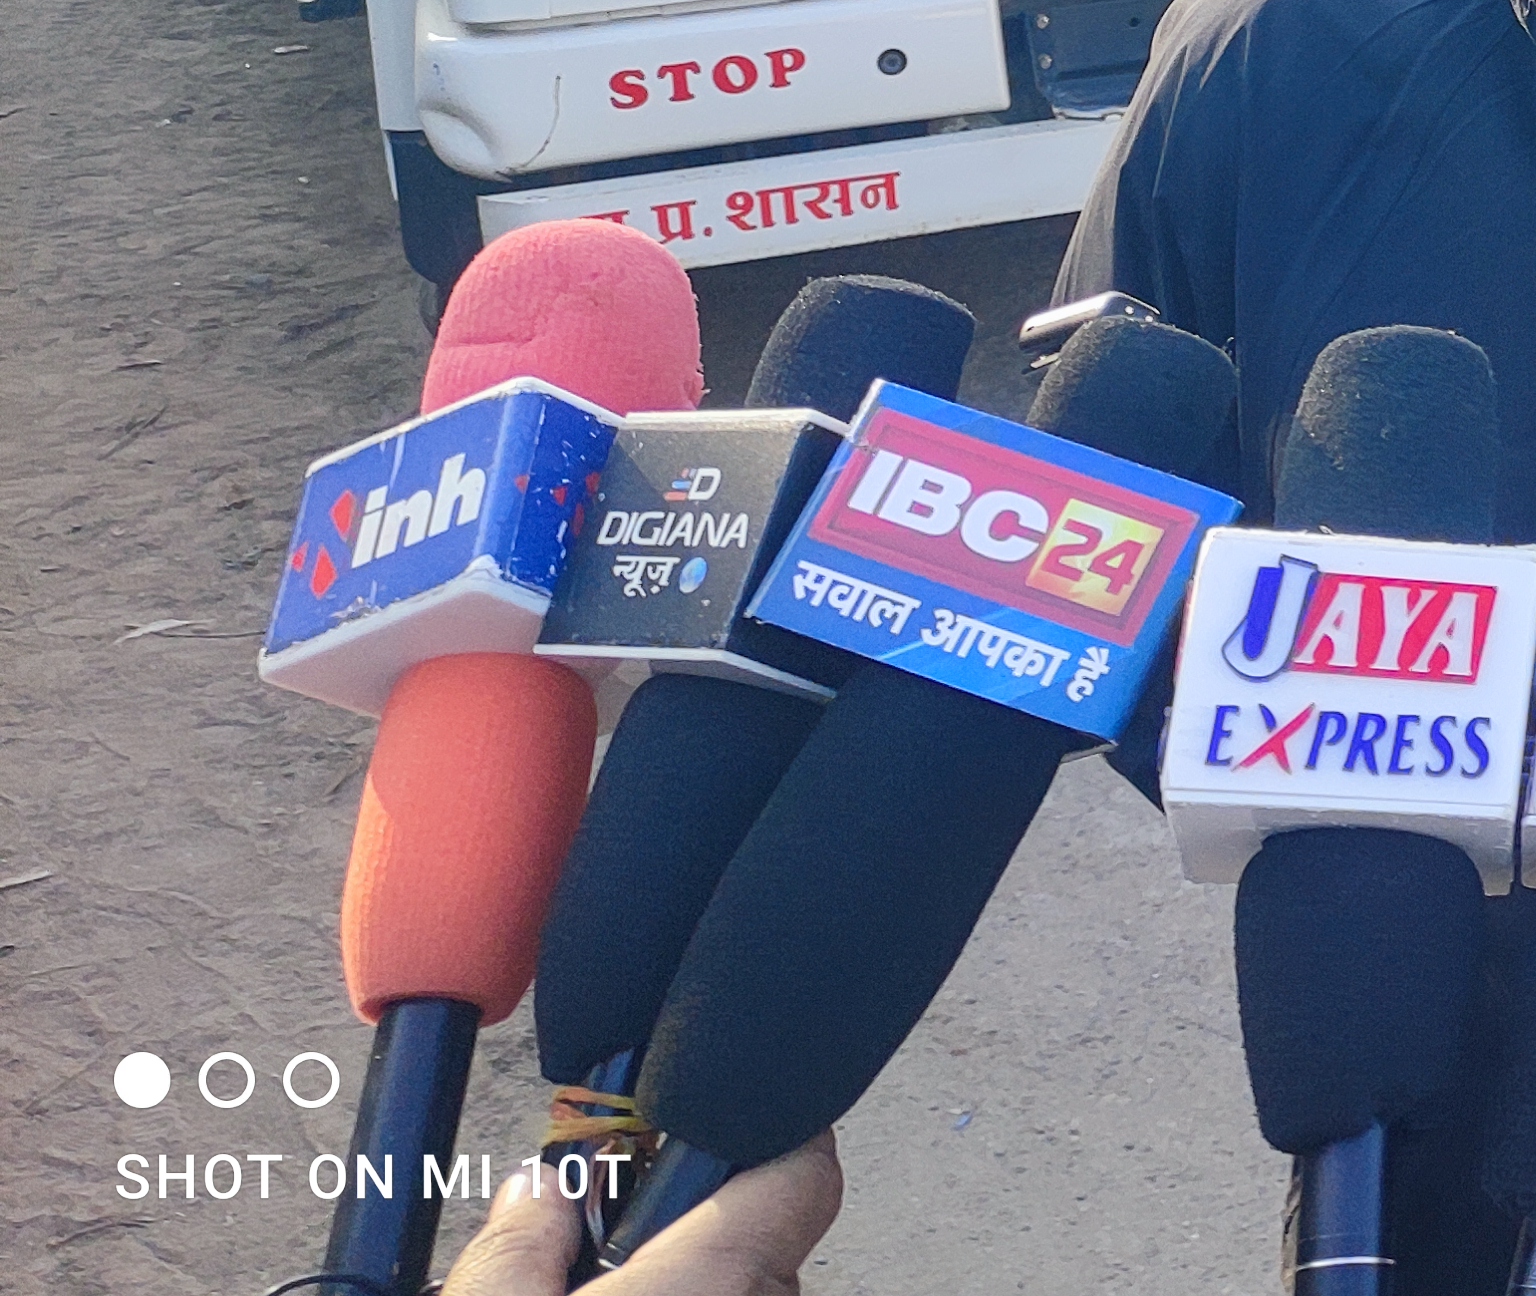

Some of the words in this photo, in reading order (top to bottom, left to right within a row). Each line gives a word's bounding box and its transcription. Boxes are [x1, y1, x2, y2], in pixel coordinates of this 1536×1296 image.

[609, 48, 806, 109] STOP
[352, 453, 487, 569] inh
[597, 511, 749, 549] DIGIANA
[793, 560, 922, 635] सवाल
[920, 607, 1070, 687] आपका
[1066, 646, 1110, 702] है
[1221, 554, 1479, 683] JAYA
[1205, 702, 1491, 779] EXPRESS
